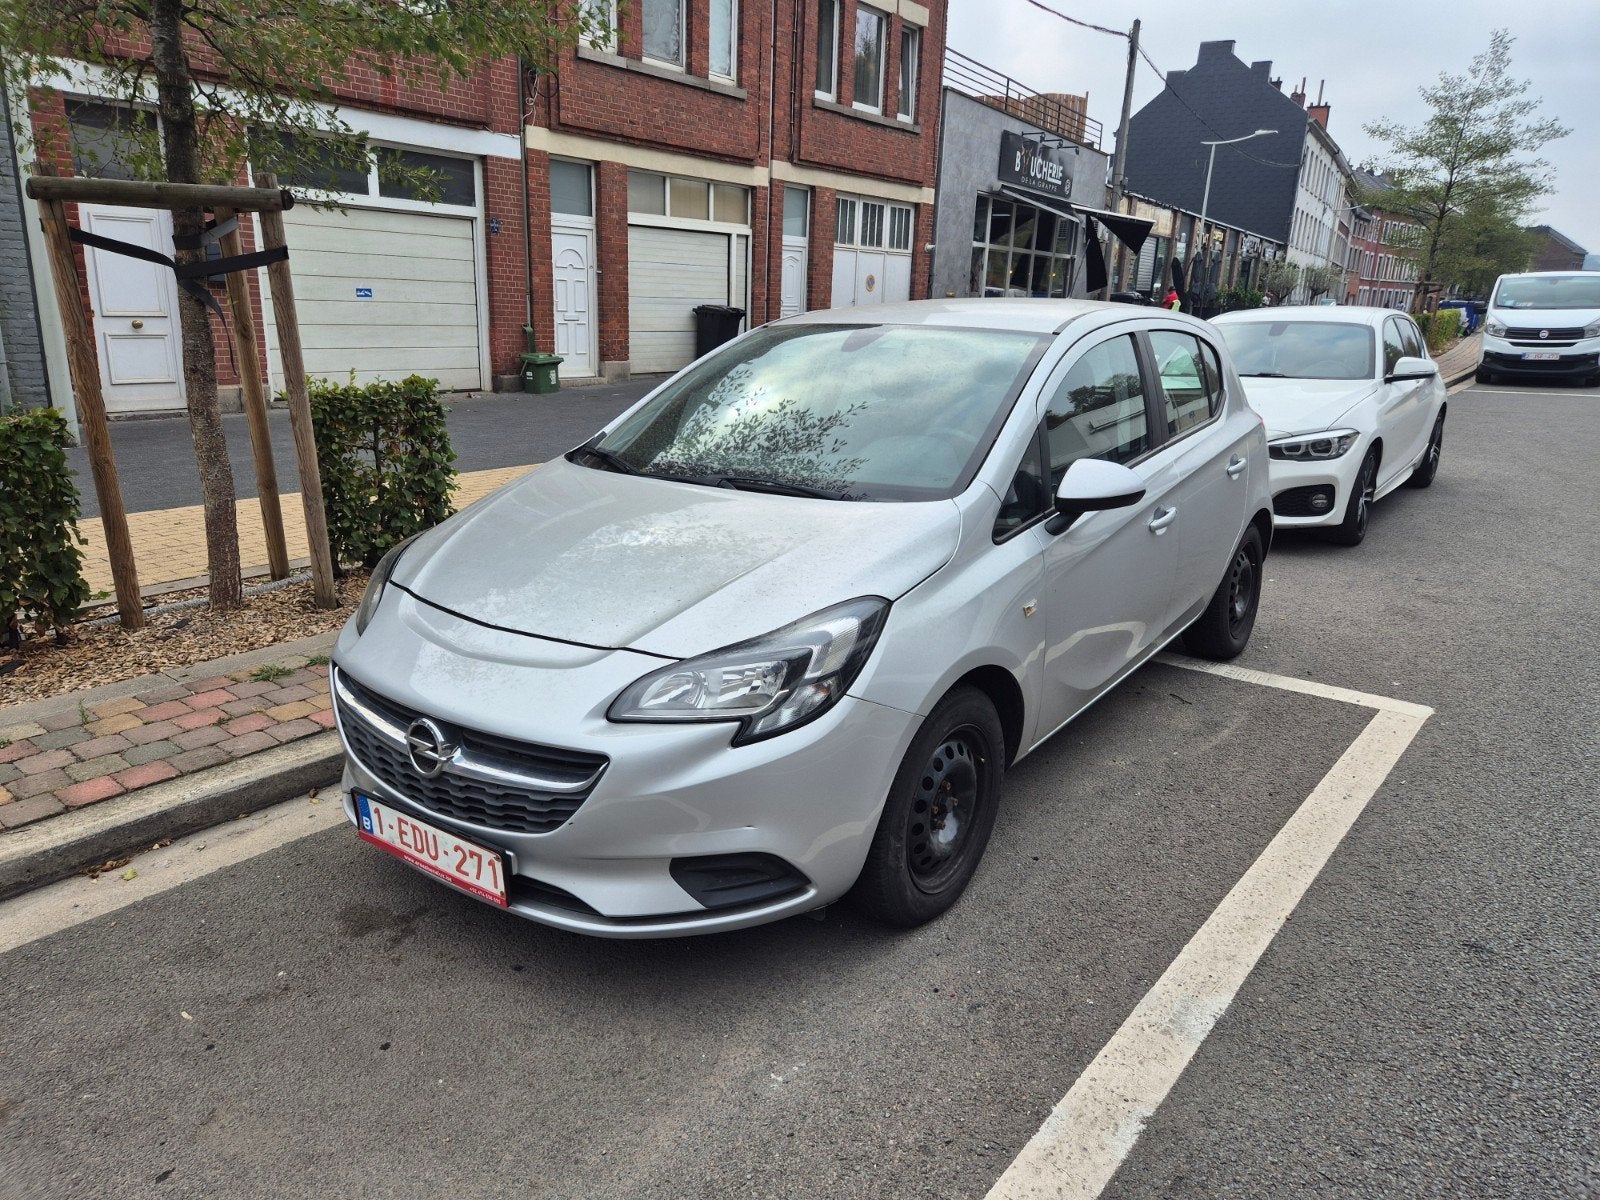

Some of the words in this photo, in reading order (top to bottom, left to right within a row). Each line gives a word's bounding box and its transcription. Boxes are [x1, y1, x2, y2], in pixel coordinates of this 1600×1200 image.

[1021, 176, 1028, 184] DE
[362, 816, 370, 830] B
[373, 806, 499, 890] 1-EDU-271
